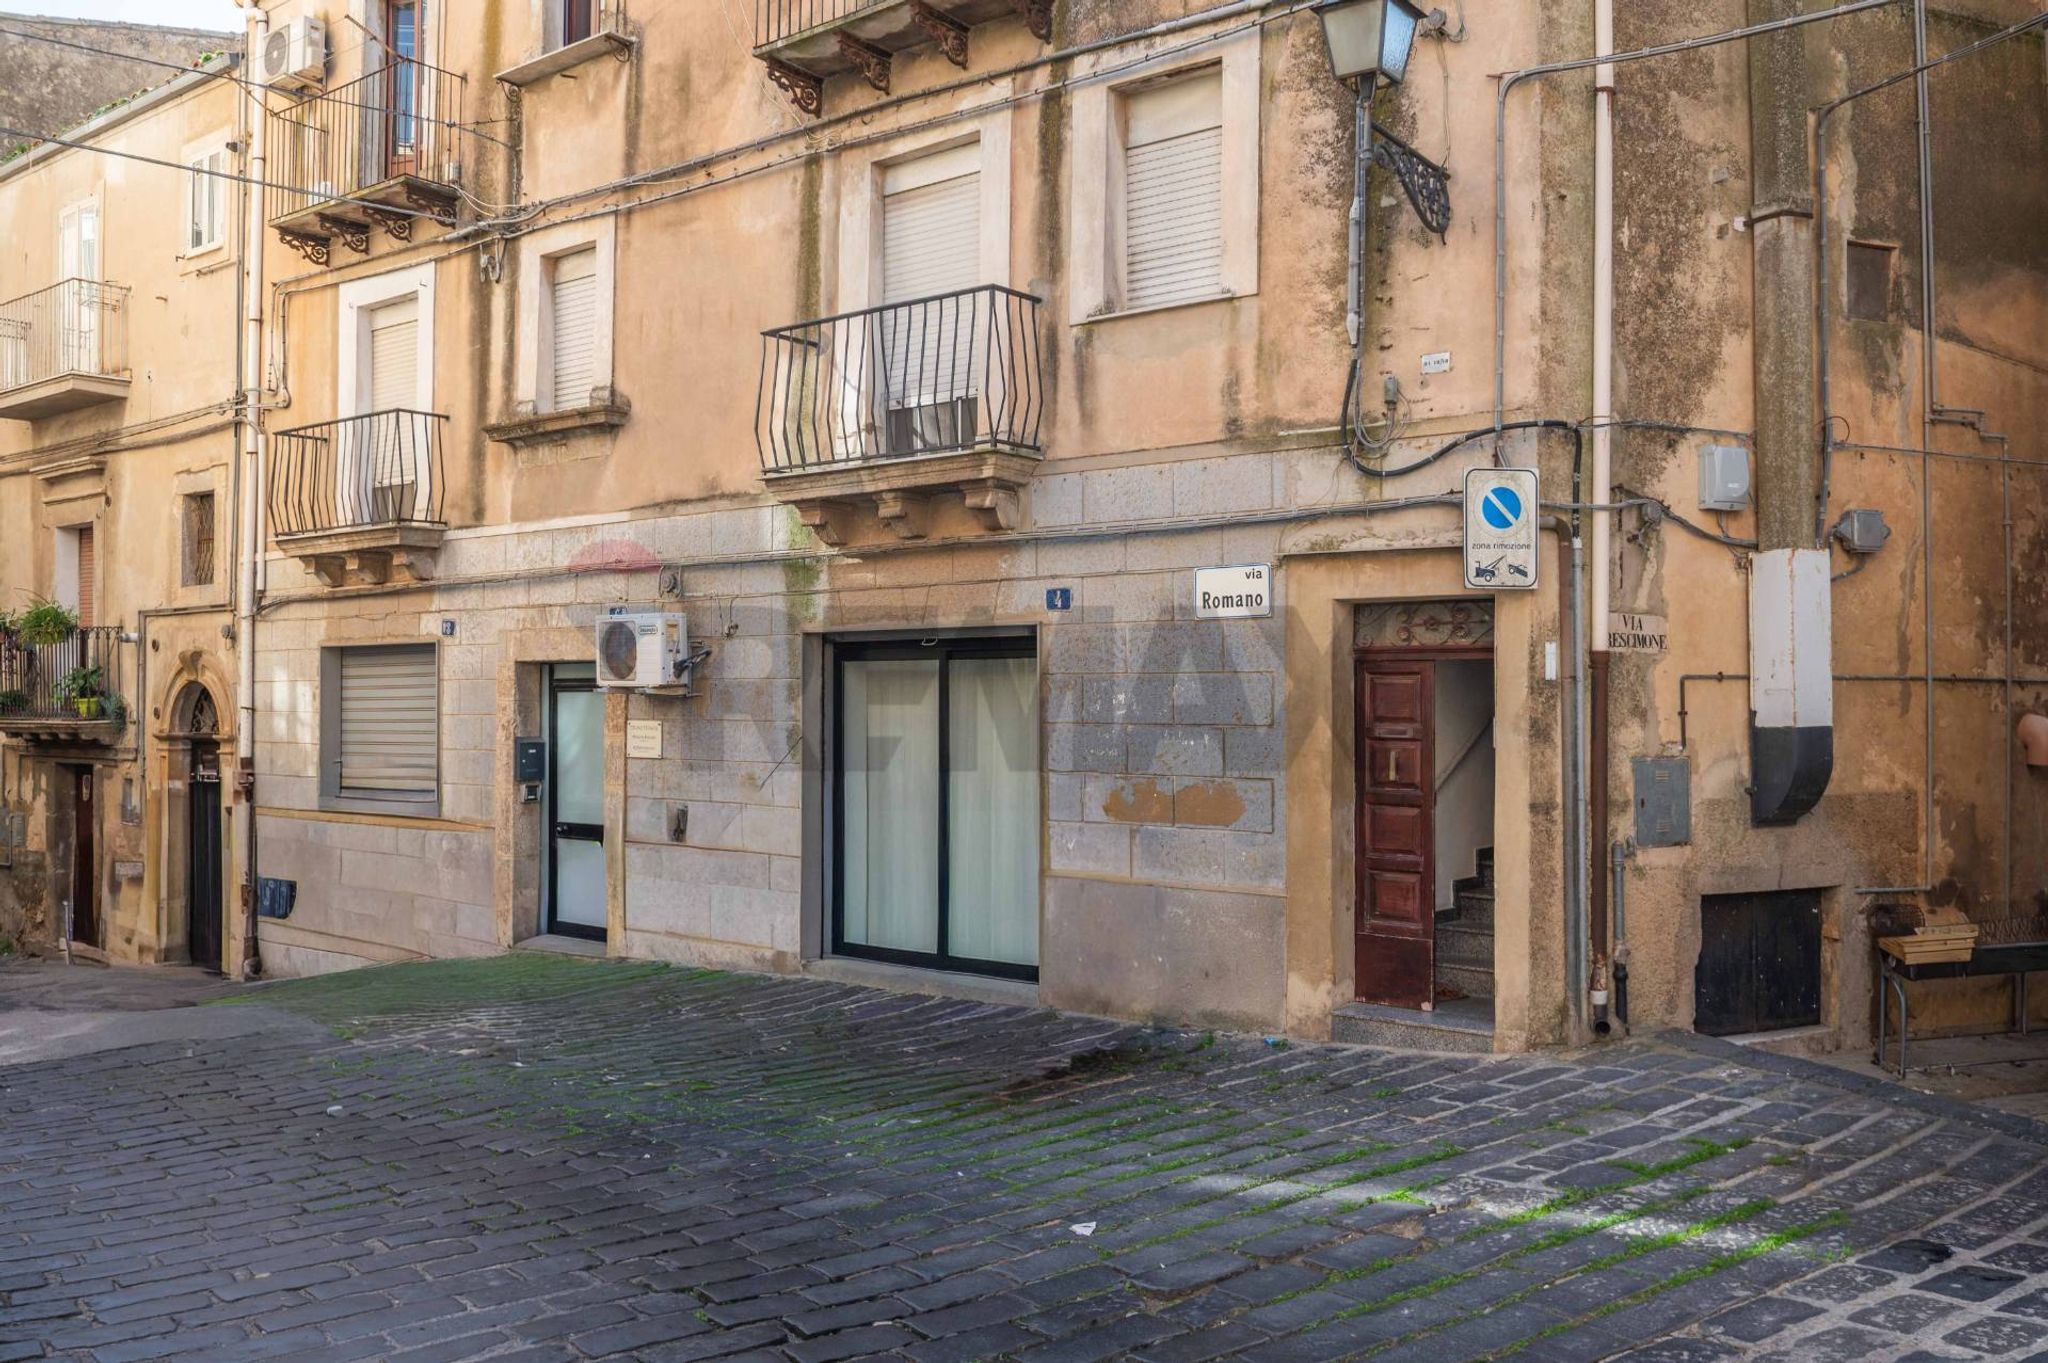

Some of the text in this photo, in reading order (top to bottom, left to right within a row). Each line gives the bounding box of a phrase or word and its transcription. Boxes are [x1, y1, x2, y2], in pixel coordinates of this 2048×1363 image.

[1493, 542, 1531, 550] rimozione
[1245, 568, 1262, 579] via
[1055, 590, 1062, 608] 4
[1202, 591, 1263, 609] Romano
[1622, 614, 1643, 631] VIA
